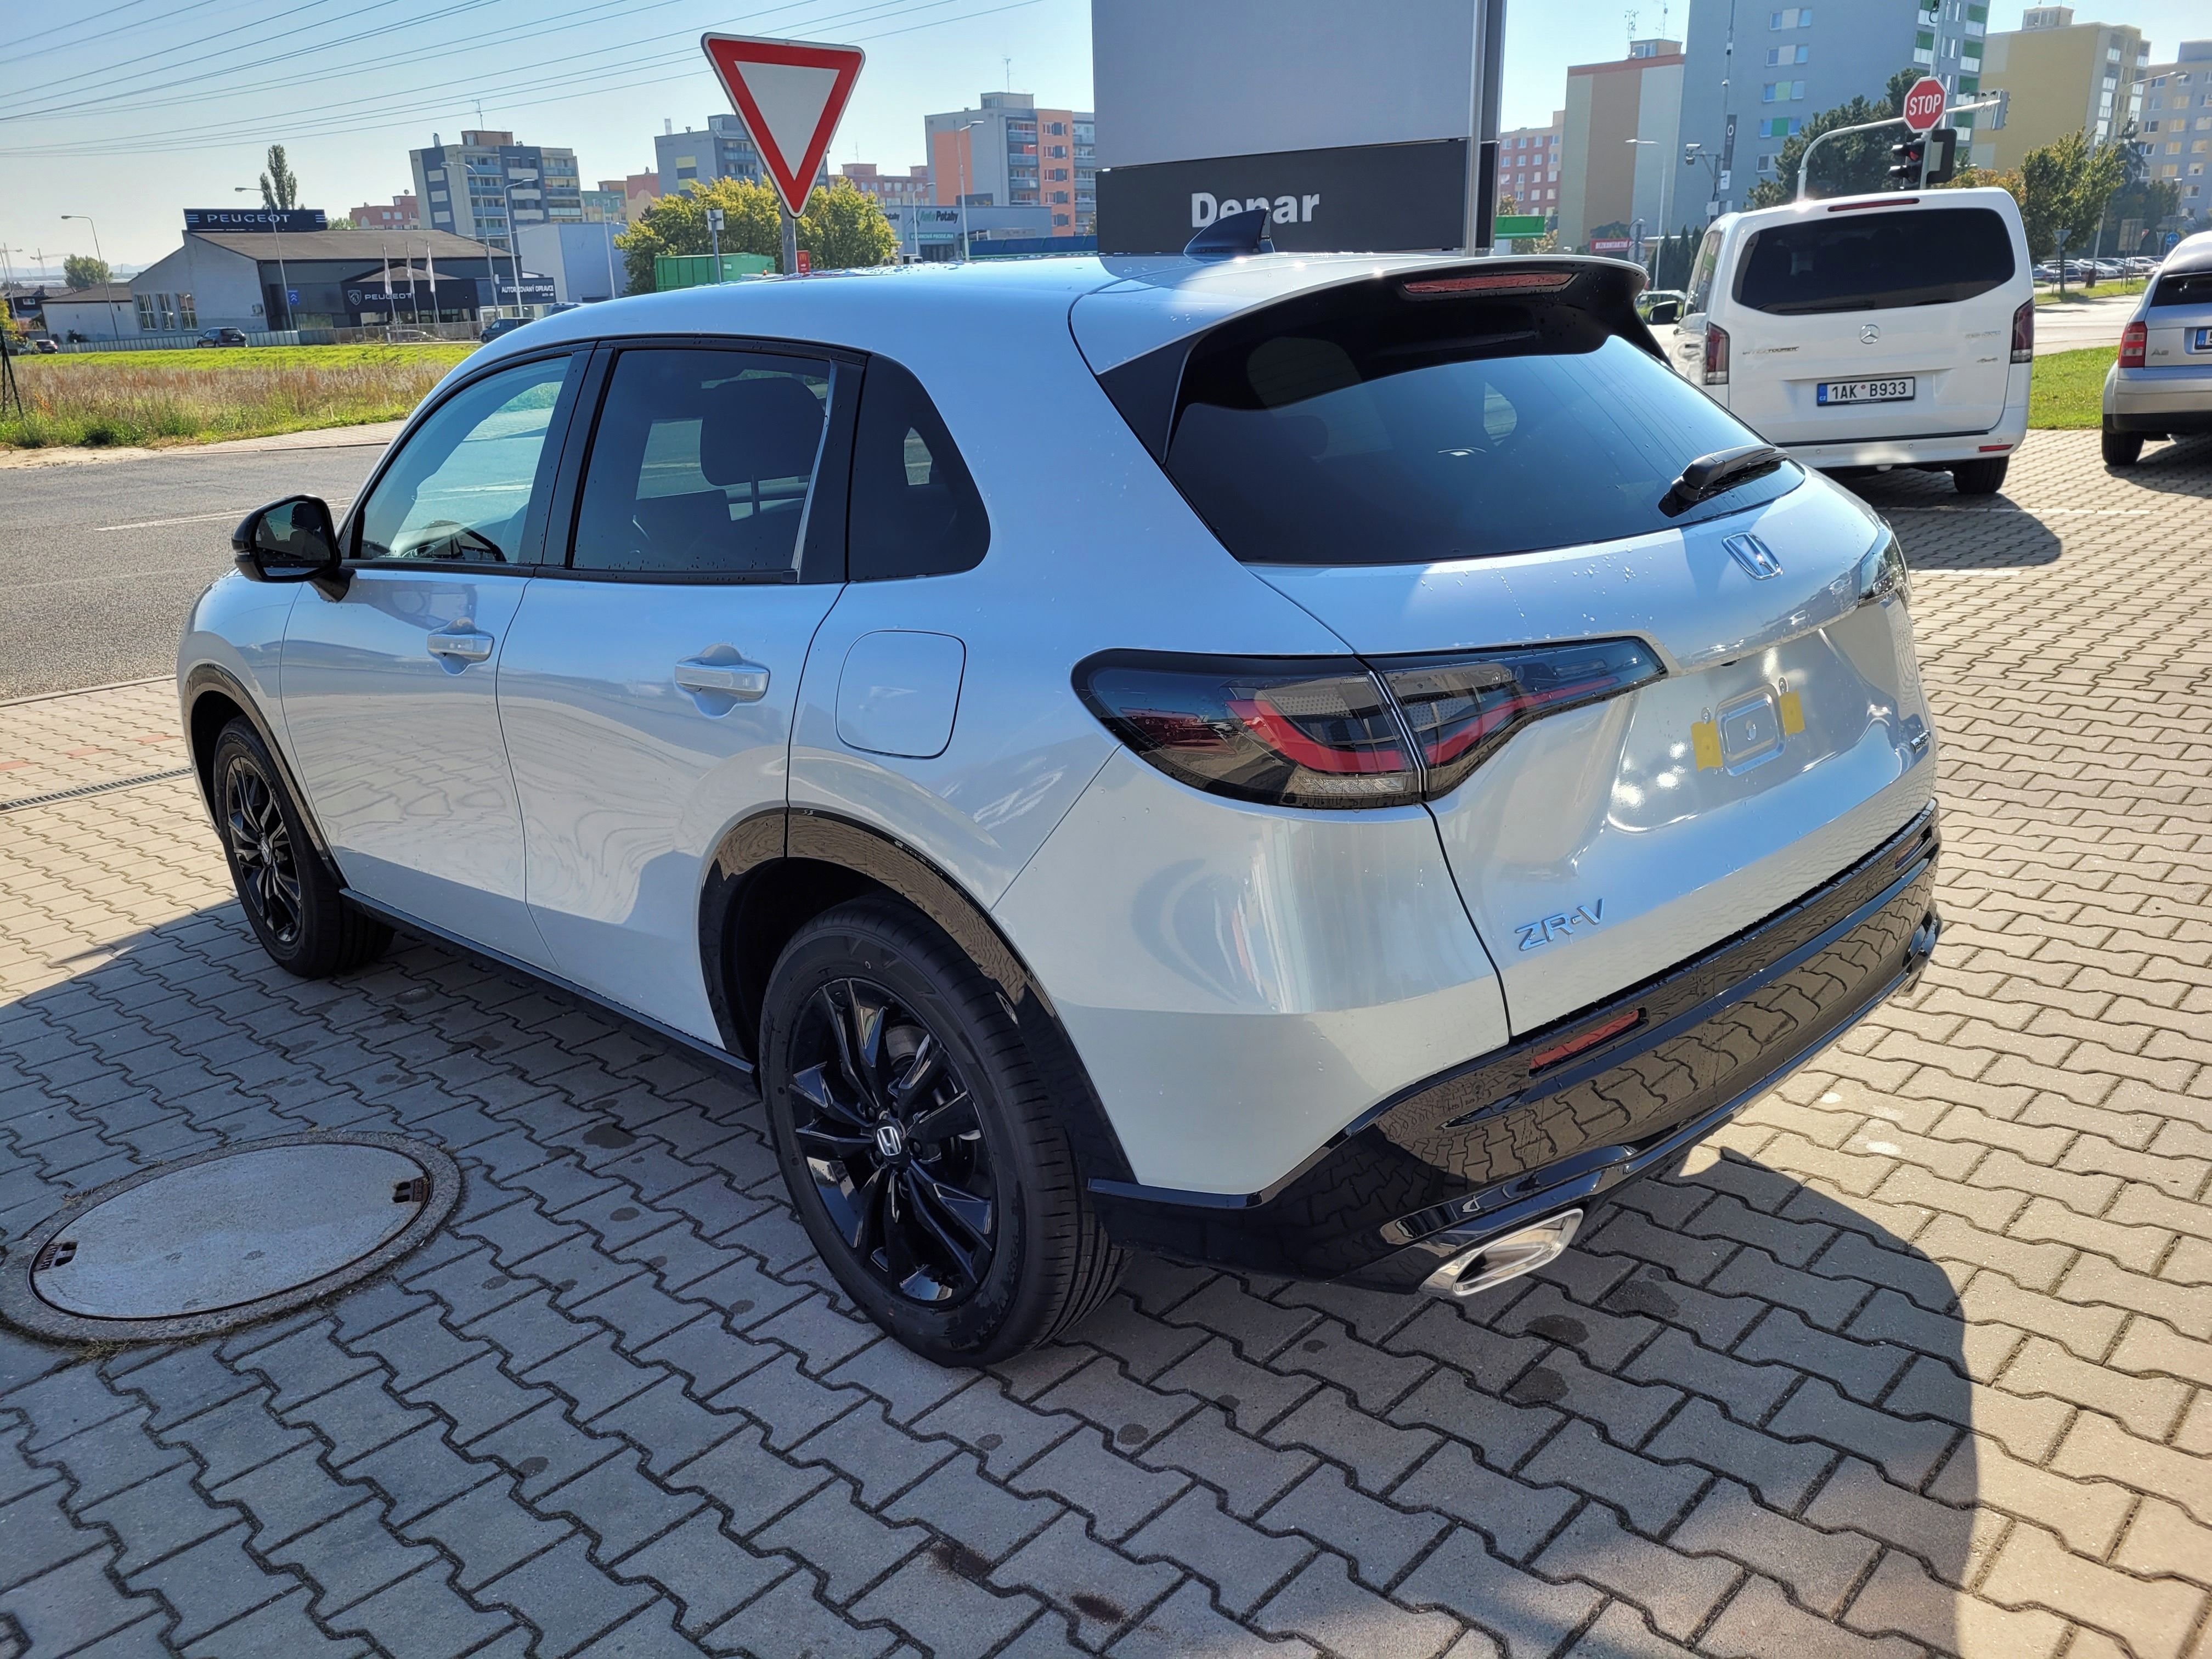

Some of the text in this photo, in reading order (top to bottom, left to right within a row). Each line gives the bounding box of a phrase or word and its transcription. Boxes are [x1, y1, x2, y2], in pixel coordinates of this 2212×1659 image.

[1909, 94, 1942, 116] STOP
[207, 214, 290, 223] PEUGEOT
[501, 284, 534, 294] AUTORZOVANÝ
[1832, 384, 1857, 399] 1AK
[1870, 381, 1906, 397] B933
[1515, 898, 1604, 951] ZR-V
